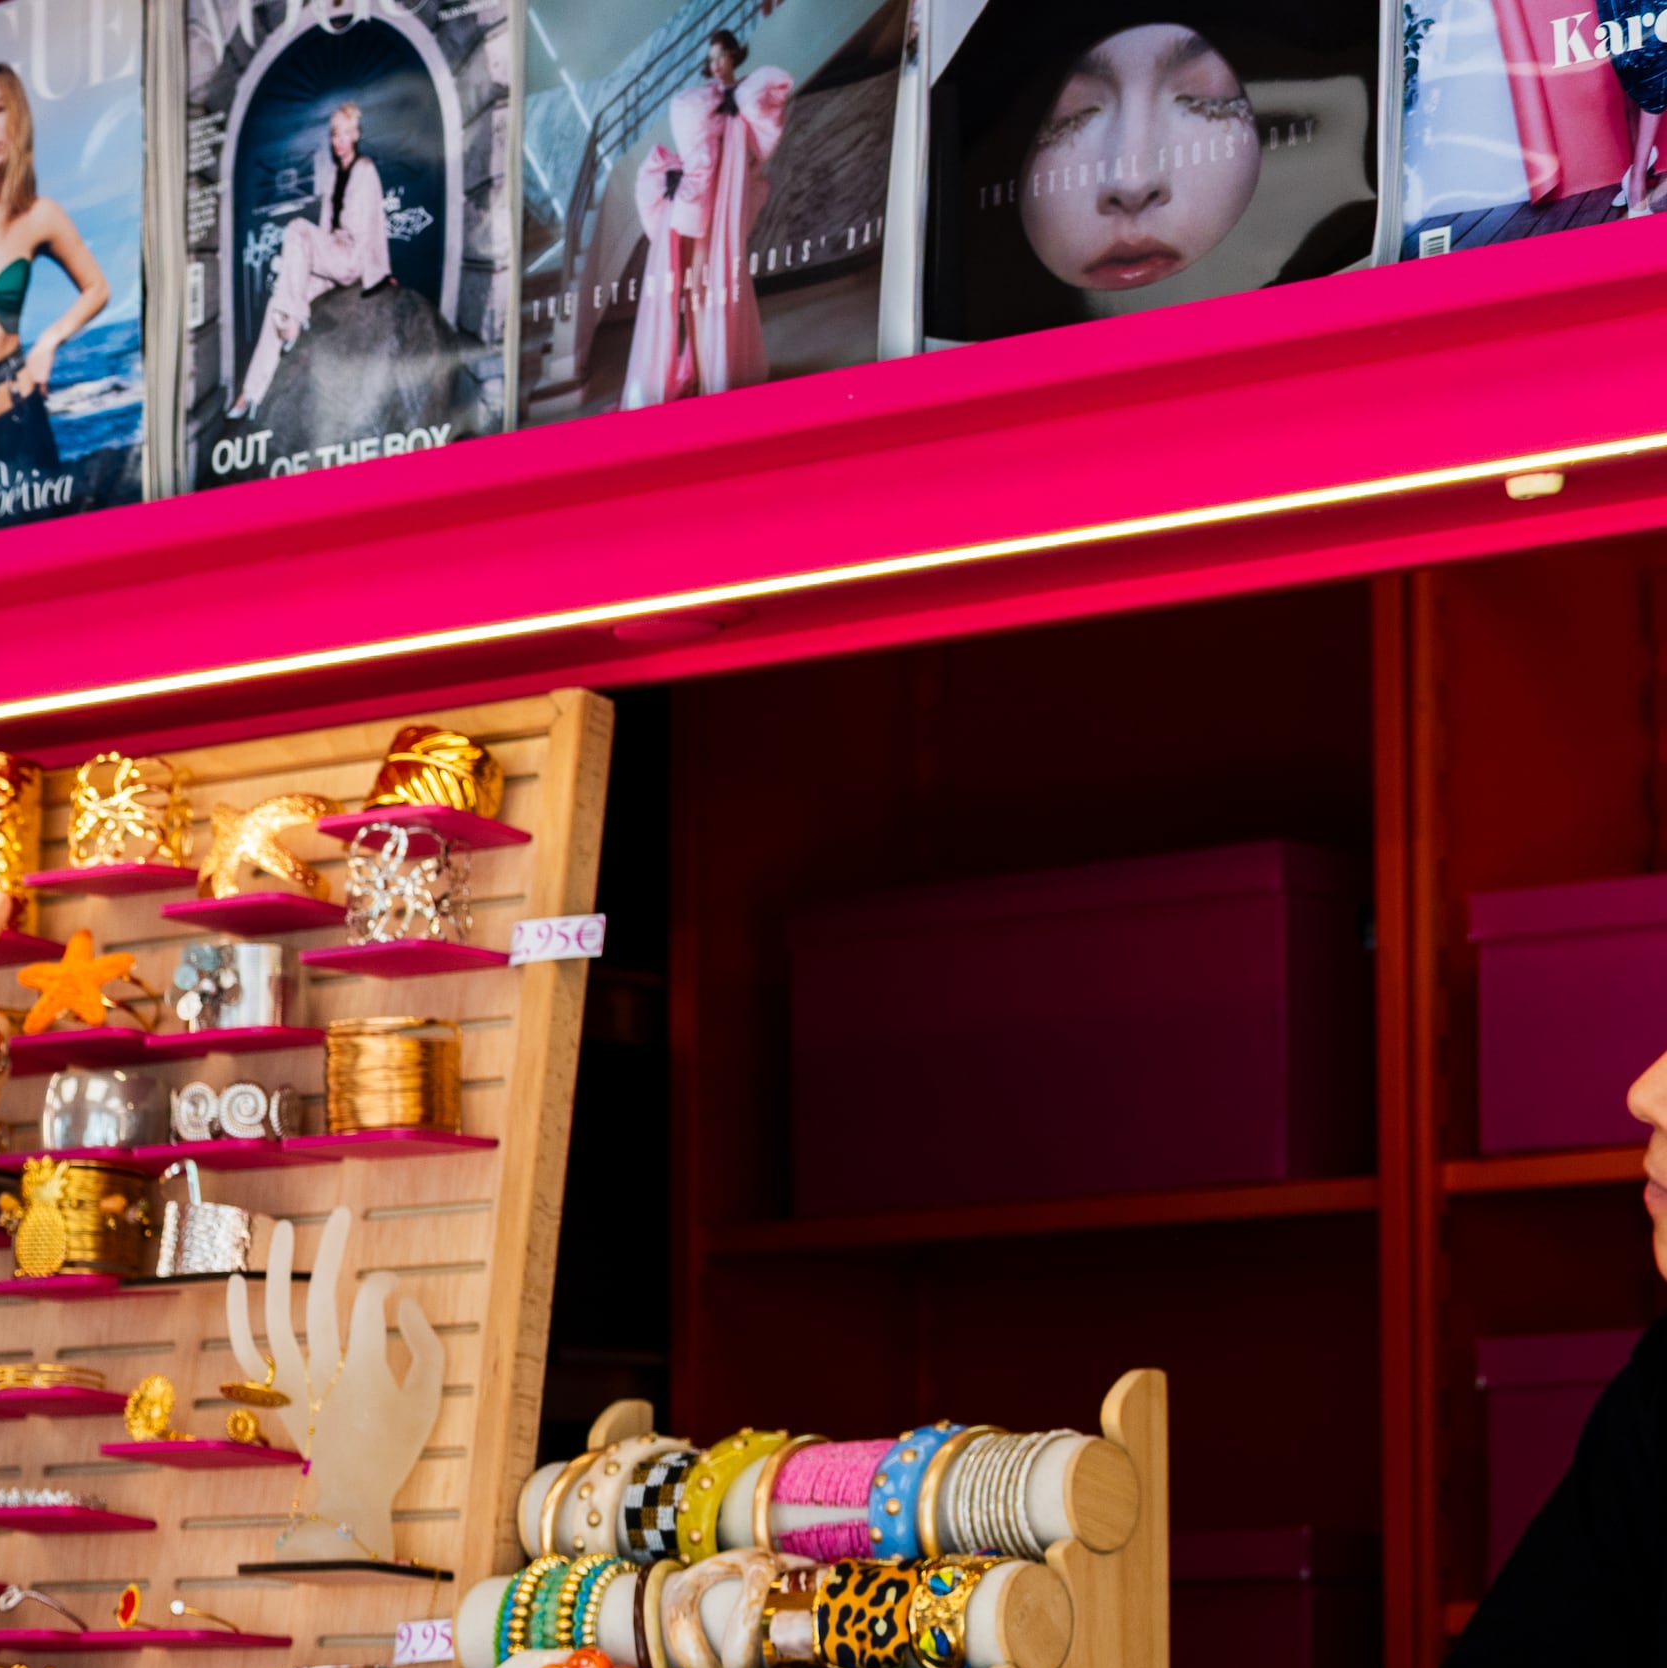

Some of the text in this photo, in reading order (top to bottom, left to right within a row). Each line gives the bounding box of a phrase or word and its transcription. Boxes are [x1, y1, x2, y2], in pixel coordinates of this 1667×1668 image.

[1033, 154, 1140, 198] ETERNAL
[211, 429, 273, 475] OUT
[316, 436, 381, 469] THE
[383, 423, 452, 457] BOX
